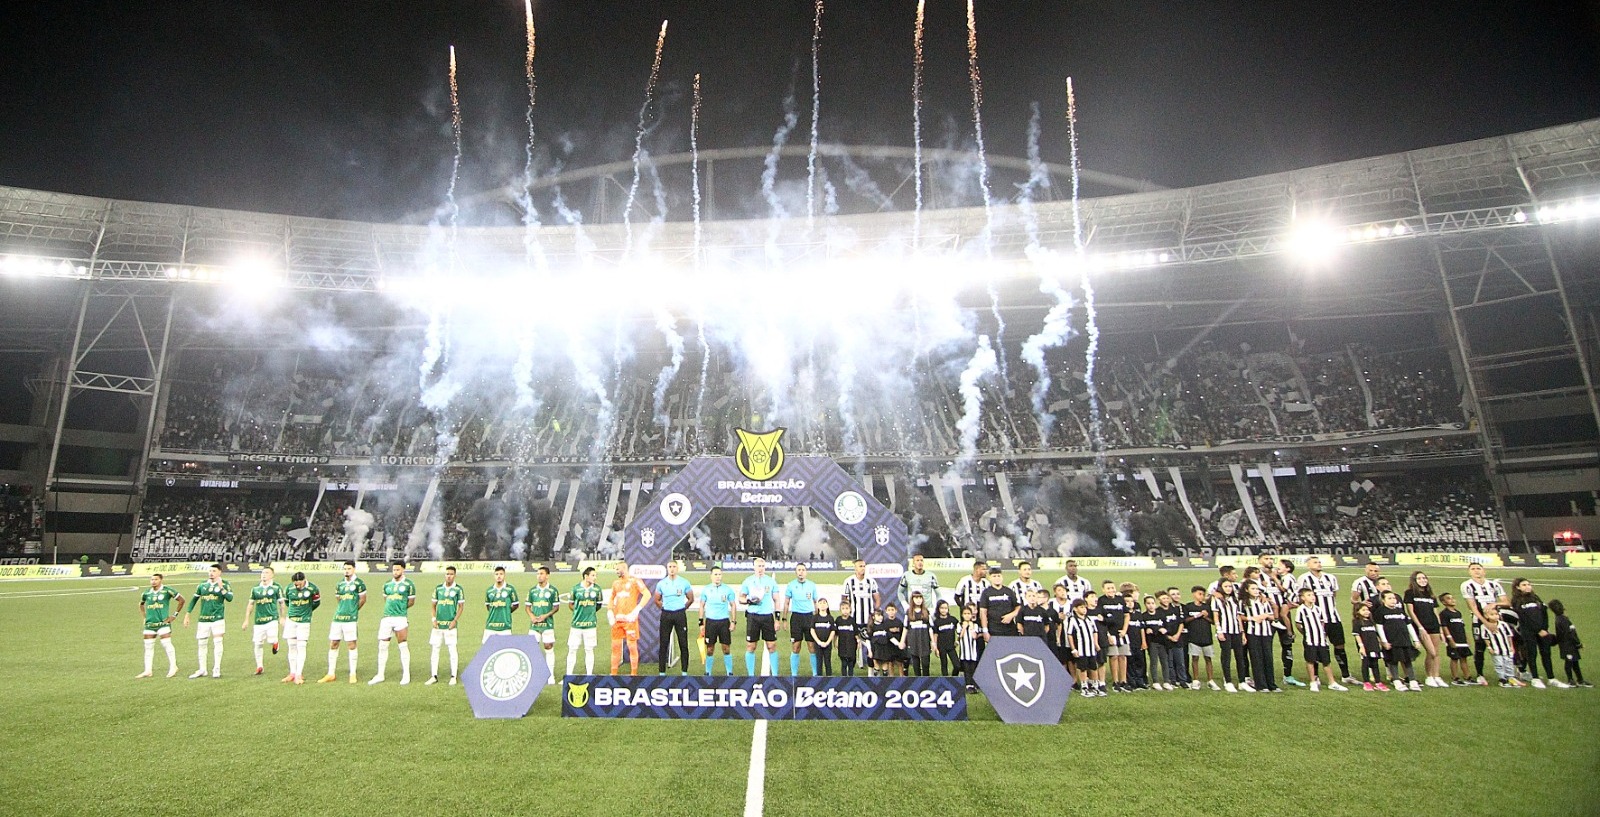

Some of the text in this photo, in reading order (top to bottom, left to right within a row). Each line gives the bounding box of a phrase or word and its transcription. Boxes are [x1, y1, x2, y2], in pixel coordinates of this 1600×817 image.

[717, 478, 806, 490] BRASILEIRÃO
[740, 492, 783, 503] Betano
[594, 683, 955, 709] BRASILEIRÃO Betano 2024
